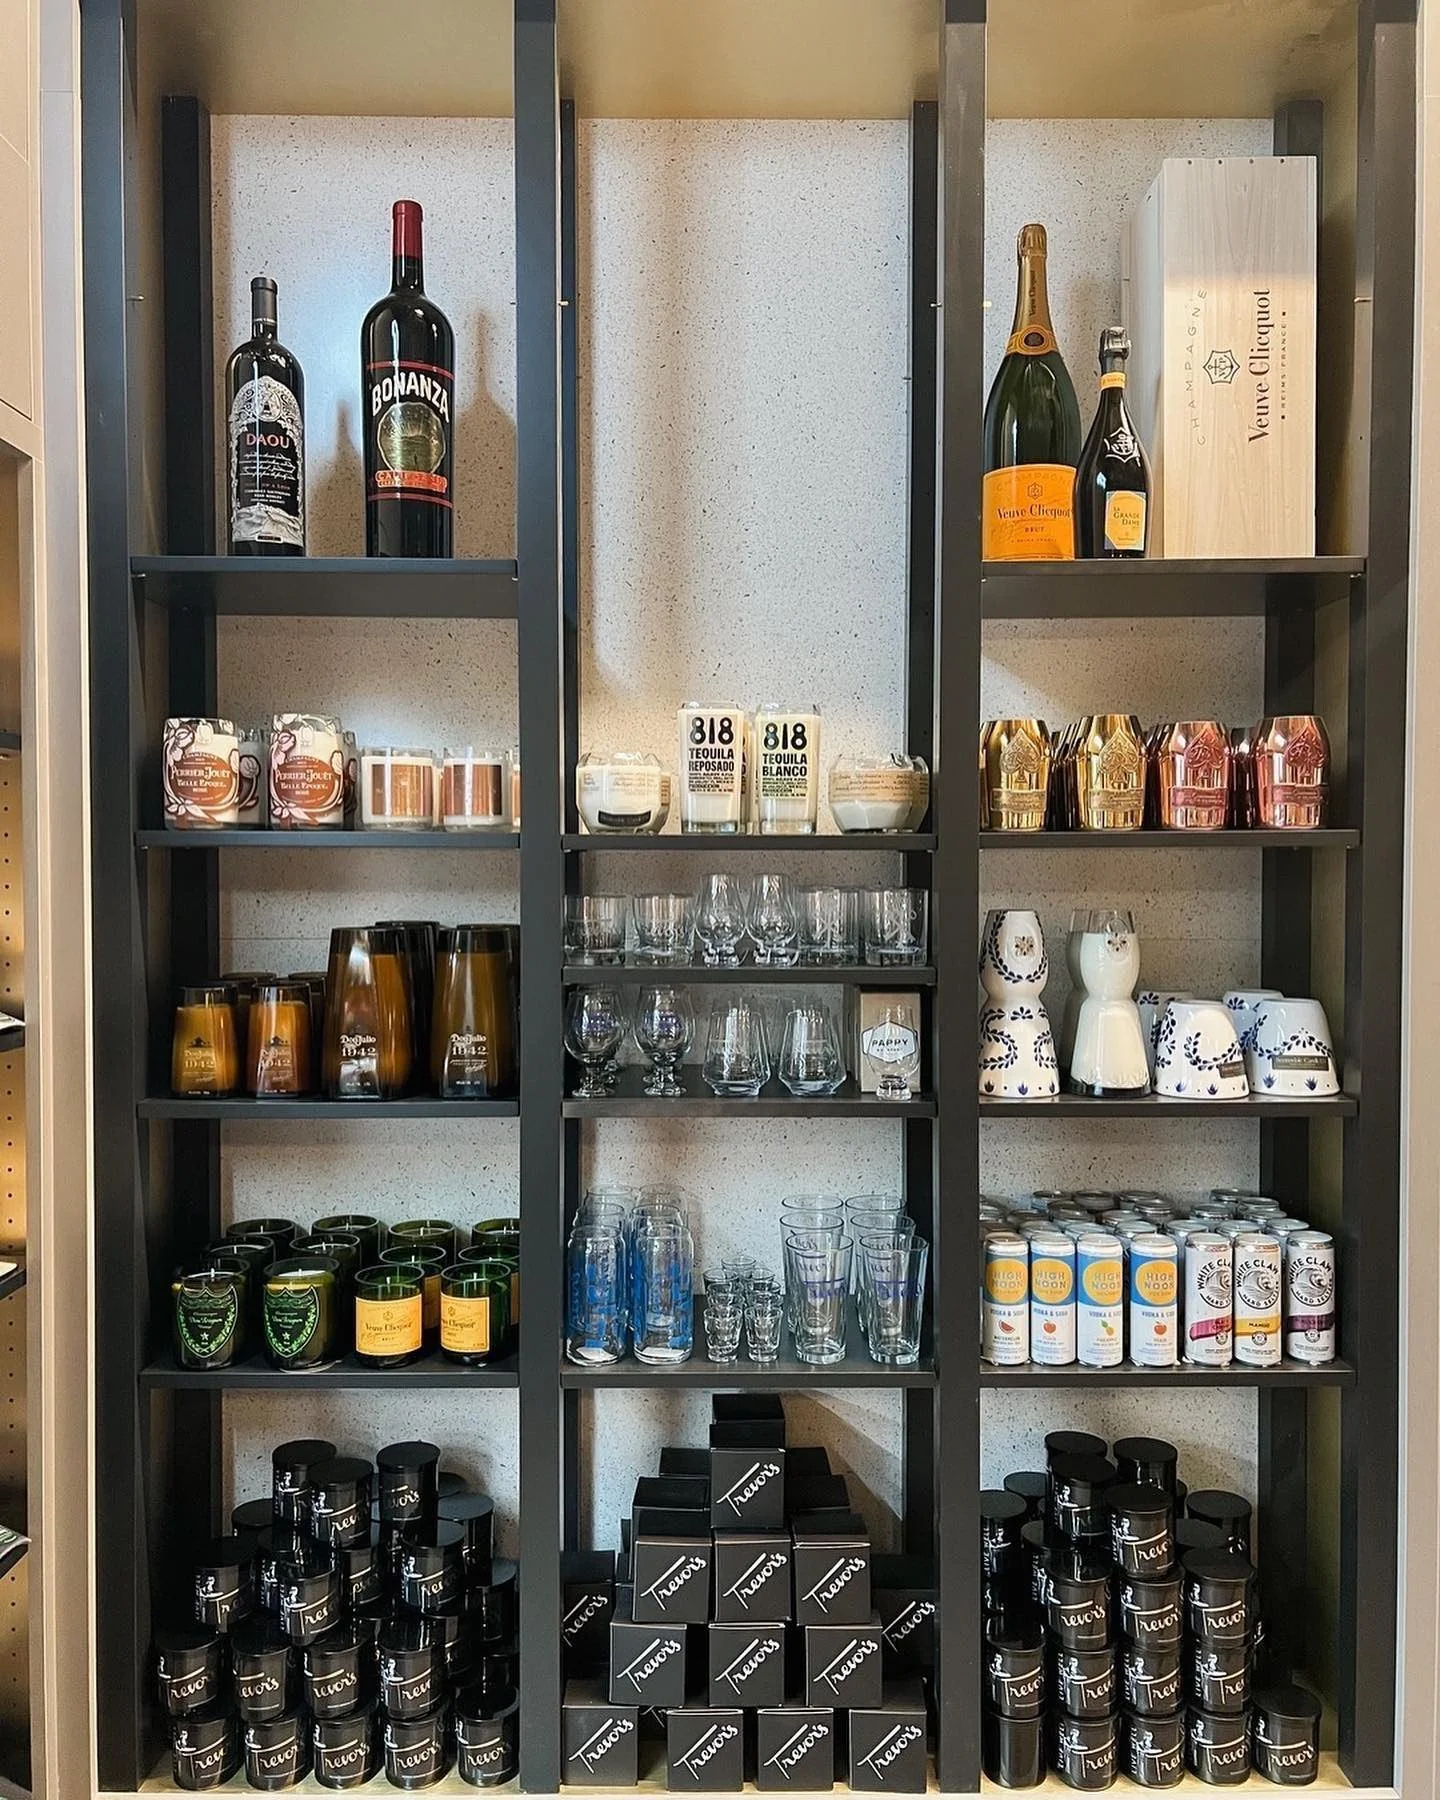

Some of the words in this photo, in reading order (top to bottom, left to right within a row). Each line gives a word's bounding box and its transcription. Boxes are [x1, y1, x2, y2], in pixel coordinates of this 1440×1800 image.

[1249, 288, 1274, 376] Clicquot
[1185, 289, 1207, 445] CHAMPAGNE
[372, 371, 450, 424] BONANZA
[1248, 382, 1270, 443] Veuve
[246, 433, 290, 449] DAOU
[997, 507, 1027, 520] Veuve
[1030, 503, 1073, 521] Clicquot
[689, 716, 734, 745] 818
[763, 722, 808, 751] 818
[688, 748, 735, 760] TEQUILA
[688, 760, 735, 772] REPOSADO
[763, 753, 808, 765] TEQUILA
[762, 765, 808, 777] BLANCO
[341, 1045, 377, 1058] 1942
[451, 1045, 489, 1057] 1942
[872, 1039, 909, 1048] PAPPY
[991, 1280, 1023, 1289] NOON
[992, 1272, 1022, 1281] HIGH
[1035, 1280, 1066, 1289] NOON
[1037, 1272, 1065, 1281] HIGH
[1146, 1272, 1174, 1281] HIGH
[1197, 1261, 1216, 1291] WHITE
[1236, 1260, 1253, 1288] WHITE
[1253, 1259, 1279, 1275] CLAW
[1289, 1257, 1305, 1285] WHITE
[1305, 1256, 1332, 1273] CLAW
[1144, 1281, 1175, 1290] NOON
[715, 1461, 781, 1518] Trevor's
[639, 1554, 707, 1611] Trevor's
[722, 1552, 788, 1610] Trevor's
[802, 1556, 867, 1614] Trevor's
[881, 1600, 936, 1654] Trevor's
[616, 1637, 682, 1694] Trevor's
[713, 1637, 781, 1696] Trevor's
[812, 1637, 879, 1696] Trevor's
[567, 1717, 635, 1774] Trevor's
[673, 1722, 740, 1781] Trevor's
[763, 1722, 830, 1781] Trevor's
[857, 1723, 923, 1781] Trevor's
[1130, 1726, 1138, 1750] WELL
[1057, 1748, 1065, 1769] LIVE
[1130, 1755, 1138, 1775] LIVE
